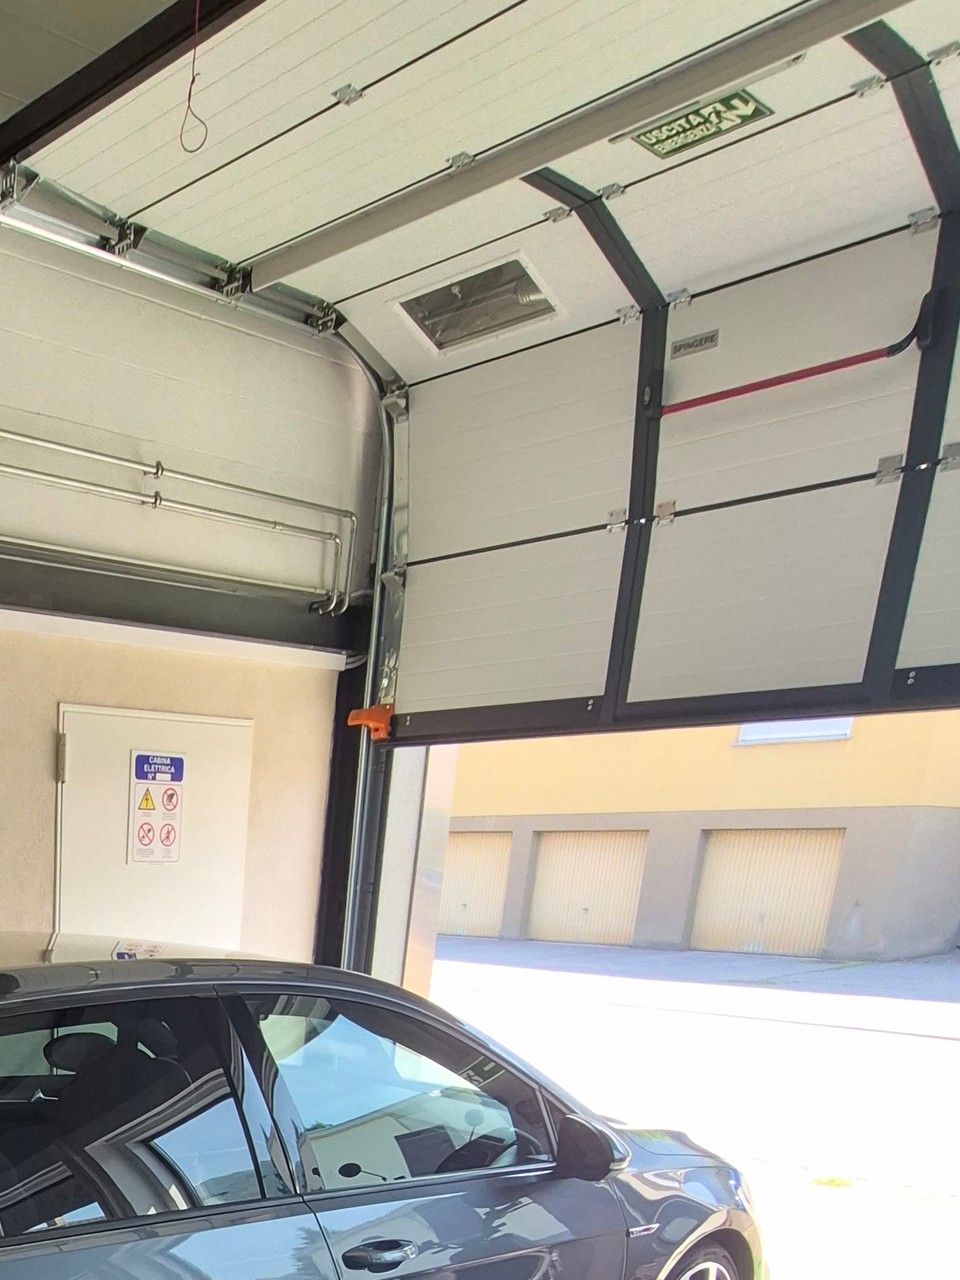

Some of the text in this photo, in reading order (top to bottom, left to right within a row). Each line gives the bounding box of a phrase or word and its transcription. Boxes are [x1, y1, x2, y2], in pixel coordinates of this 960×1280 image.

[639, 114, 705, 145] USCITA
[672, 333, 717, 355] SPINGERE
[149, 756, 171, 764] CABINA
[143, 764, 176, 773] ELETTRICA
